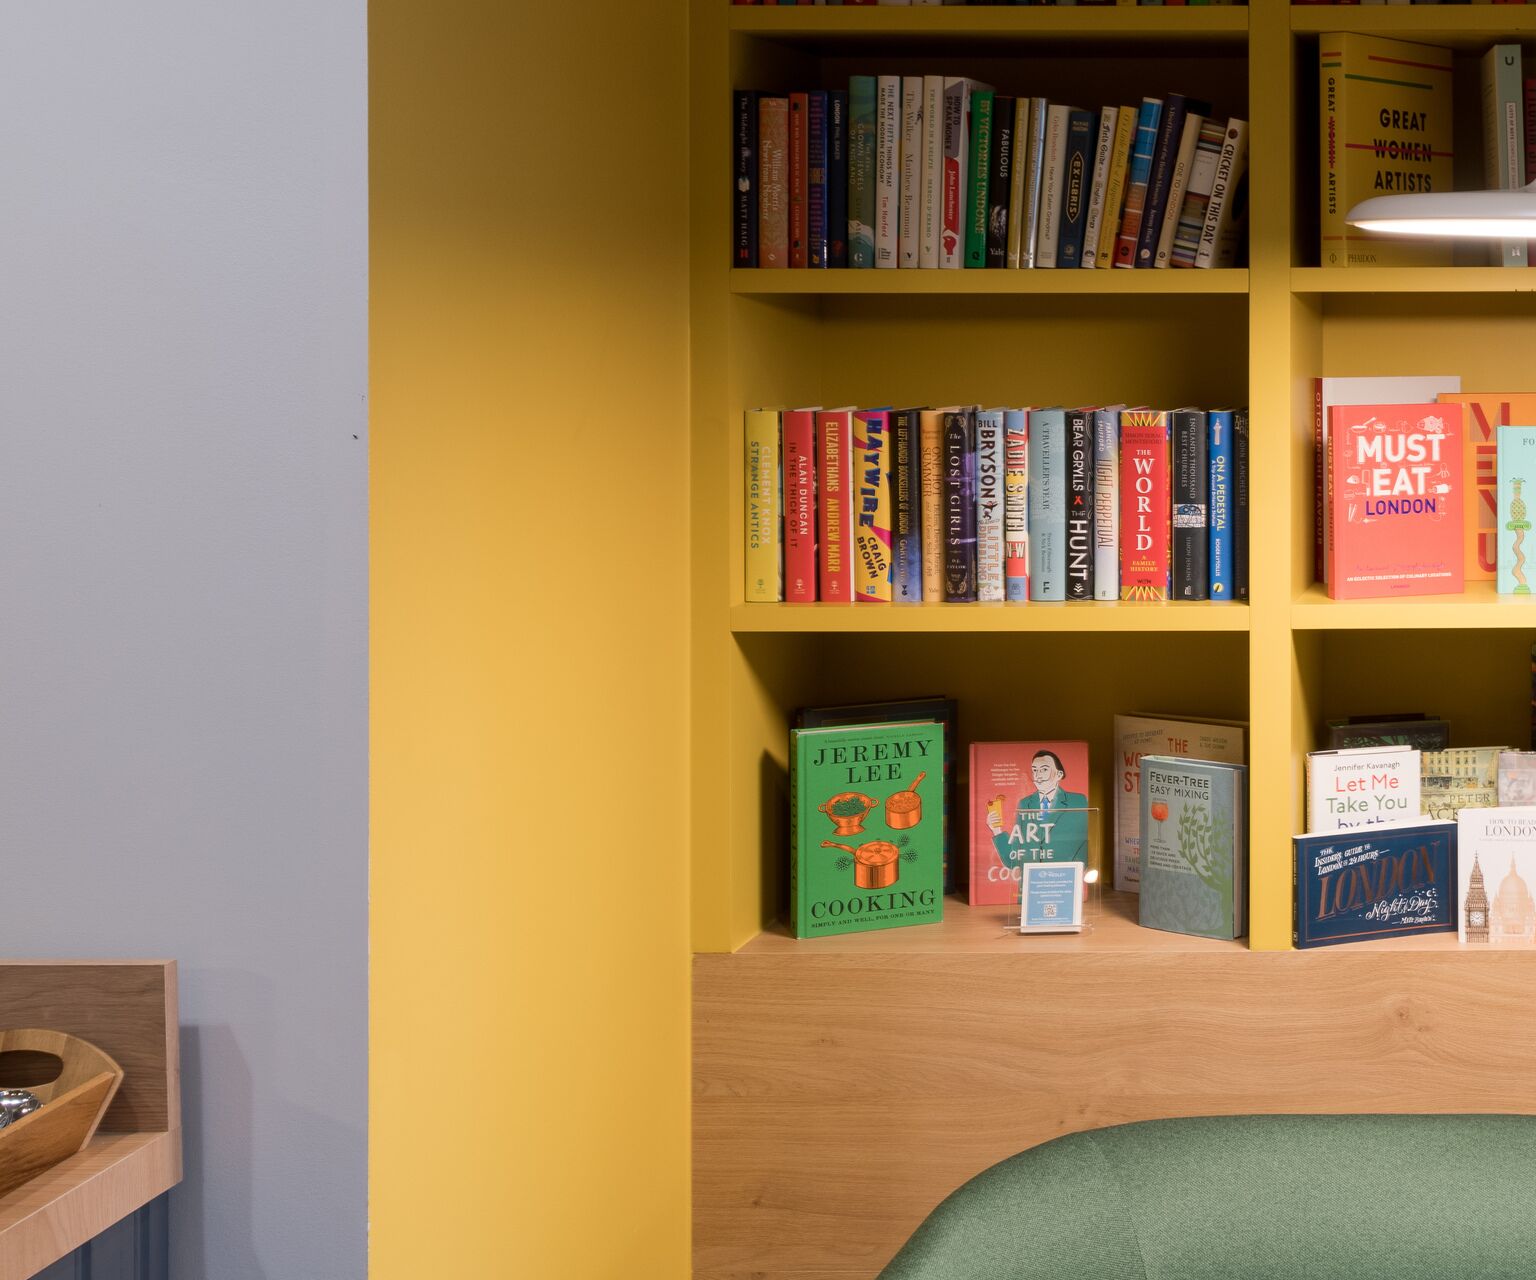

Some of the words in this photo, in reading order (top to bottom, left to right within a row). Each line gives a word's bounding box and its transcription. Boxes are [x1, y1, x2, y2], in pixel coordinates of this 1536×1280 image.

[1379, 109, 1426, 132] GREAT
[1000, 129, 1009, 178] FABULOUS
[1218, 144, 1234, 181] CRICKET
[1373, 139, 1431, 162] WOMEN
[1214, 184, 1224, 199] ON
[1374, 171, 1431, 193] ARTISTS
[1208, 201, 1220, 221] THIS
[1203, 224, 1216, 244] DAY
[979, 420, 997, 428] BILL
[1073, 419, 1083, 446] BEAR
[826, 422, 839, 491] ELIZABETHANS
[981, 430, 996, 497] BRYSON
[1007, 428, 1025, 476] ZADIE
[1357, 434, 1445, 464] MUST
[799, 455, 807, 484] ALAN
[859, 419, 883, 528] HAYWIRE
[950, 445, 960, 488] LOST
[1073, 450, 1083, 491] GRYLLS
[1216, 456, 1224, 472] ON
[1373, 467, 1432, 496] EAT
[799, 489, 807, 535] DUNCAN
[827, 498, 840, 539] ANDREW
[1008, 483, 1024, 531] SMITH
[1133, 458, 1154, 551] WORLD
[1216, 484, 1225, 531] PEDESTAL
[1366, 499, 1436, 515] LONDON
[950, 495, 961, 545] GIRLS
[828, 545, 840, 572] MARR
[857, 537, 877, 578] BROWN
[868, 537, 887, 571] CRAIG
[1070, 520, 1087, 580] HUNT
[814, 740, 933, 766] JEREMY
[1366, 761, 1400, 770] Kavanagh
[846, 764, 902, 784] LEE
[1336, 778, 1365, 792] Let
[1372, 775, 1399, 789] Me
[1150, 785, 1170, 795] EASY
[1174, 789, 1209, 800] MIXING
[1326, 798, 1368, 813] Take
[1375, 795, 1407, 810] You
[1020, 812, 1043, 821] THE
[1008, 823, 1055, 844] ART
[1031, 849, 1053, 859] THE
[1317, 845, 1440, 920] LONDON
[811, 889, 935, 919] COOKING
[1366, 899, 1403, 921] Night
[1408, 896, 1437, 911] Day
